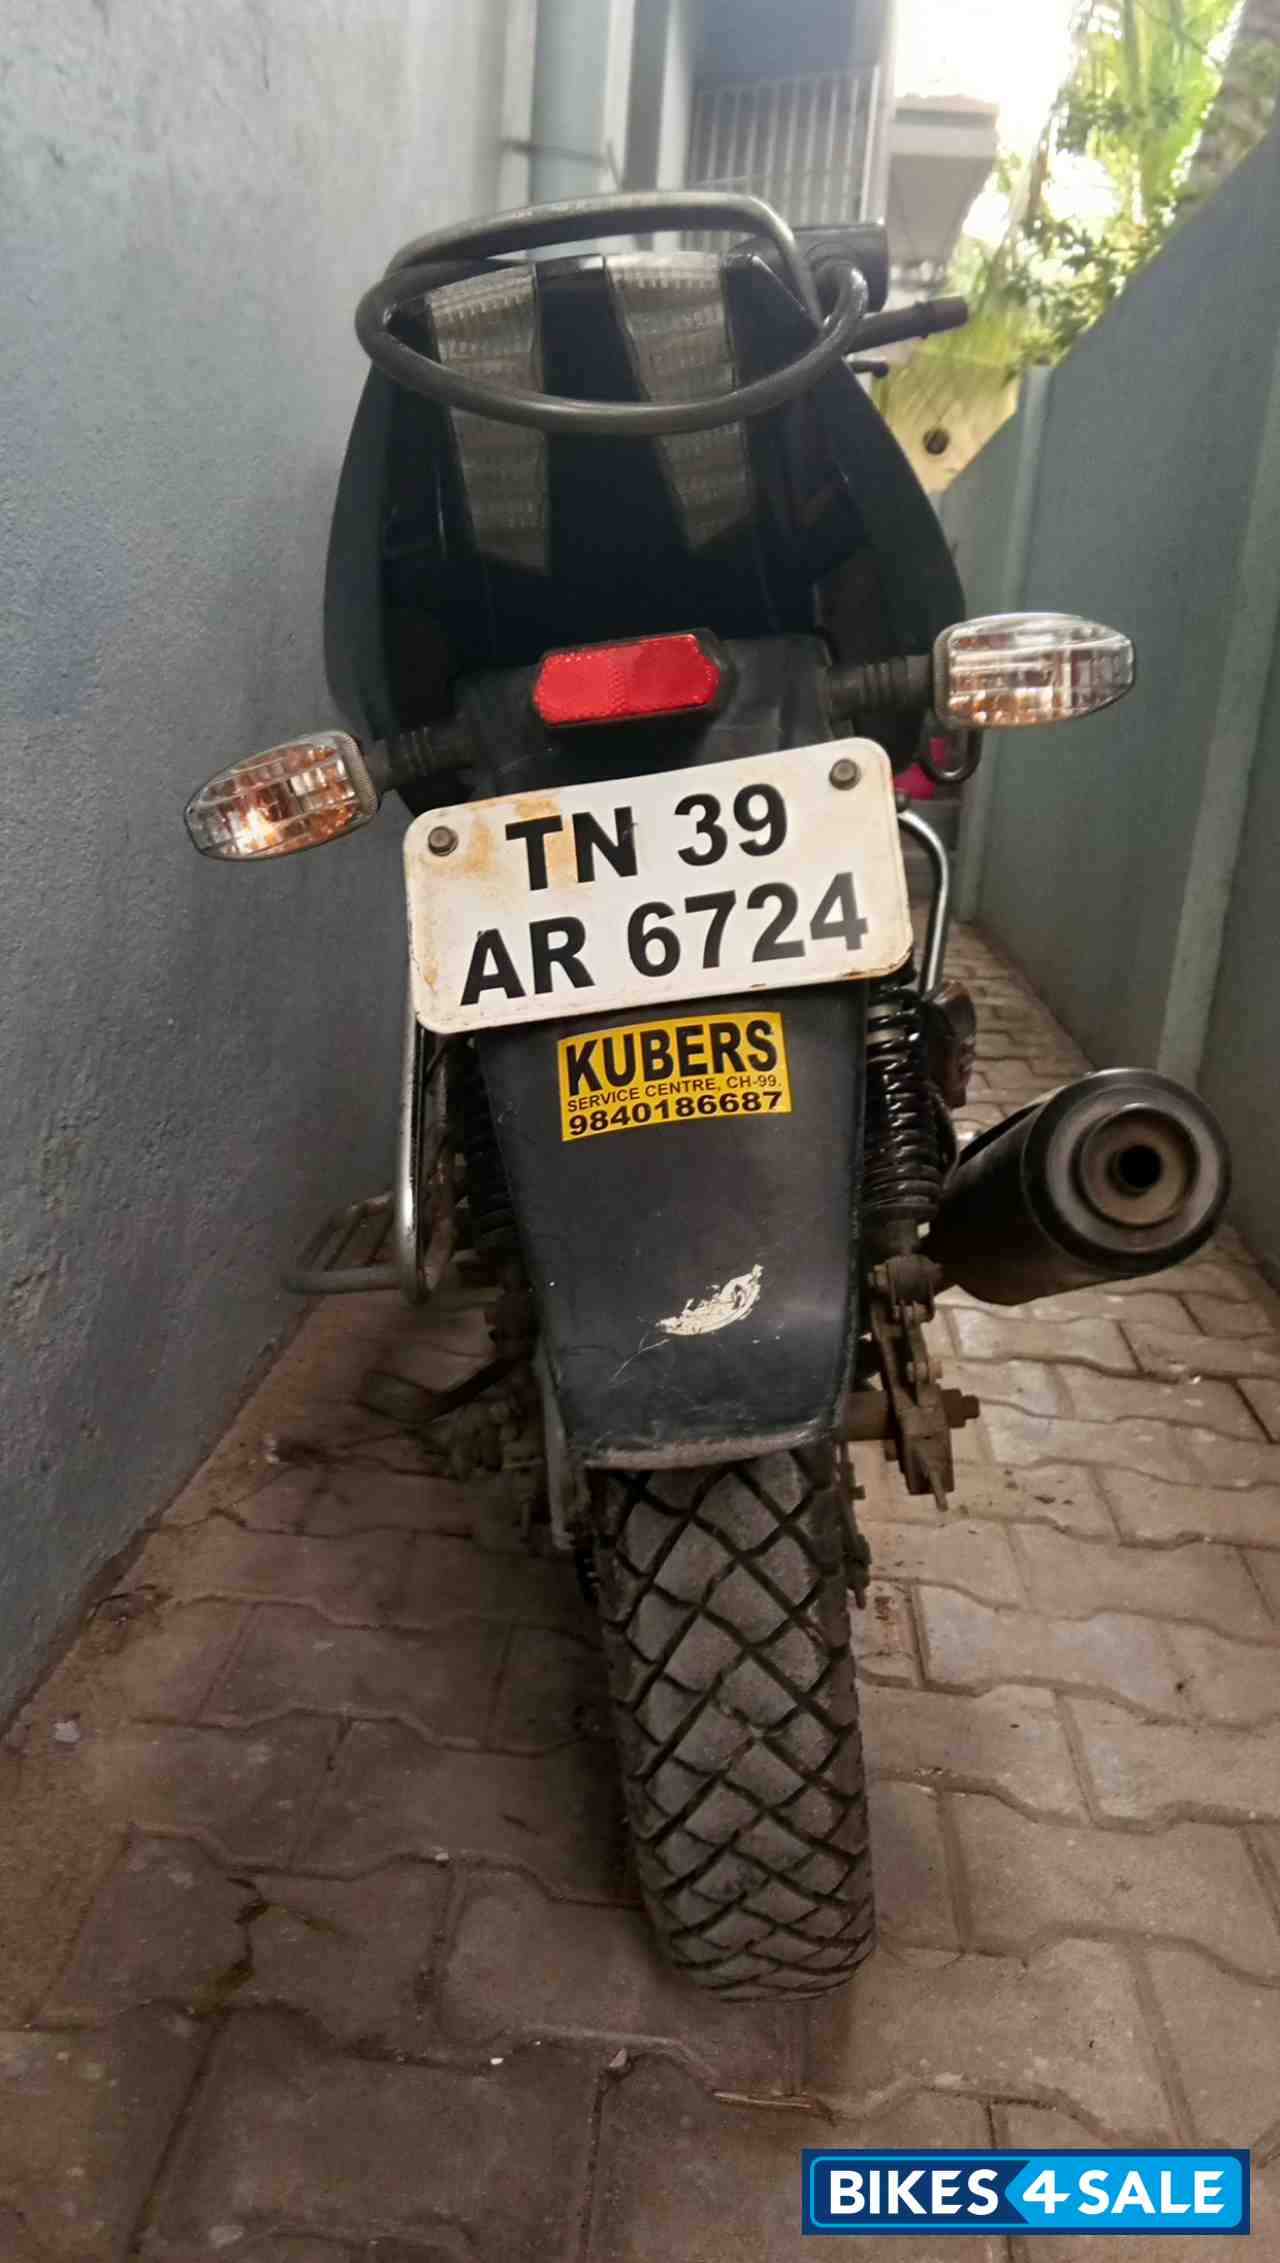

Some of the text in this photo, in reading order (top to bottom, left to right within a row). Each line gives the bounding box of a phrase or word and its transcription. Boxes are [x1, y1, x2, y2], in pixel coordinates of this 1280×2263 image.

[506, 783, 787, 891] TN 39
[460, 872, 869, 1006] AR 6724
[565, 1019, 777, 1097] KUBERS
[568, 1087, 641, 1113] SERVICE
[645, 1077, 721, 1098] CENTRE,
[569, 1091, 783, 1136] 9840186687
